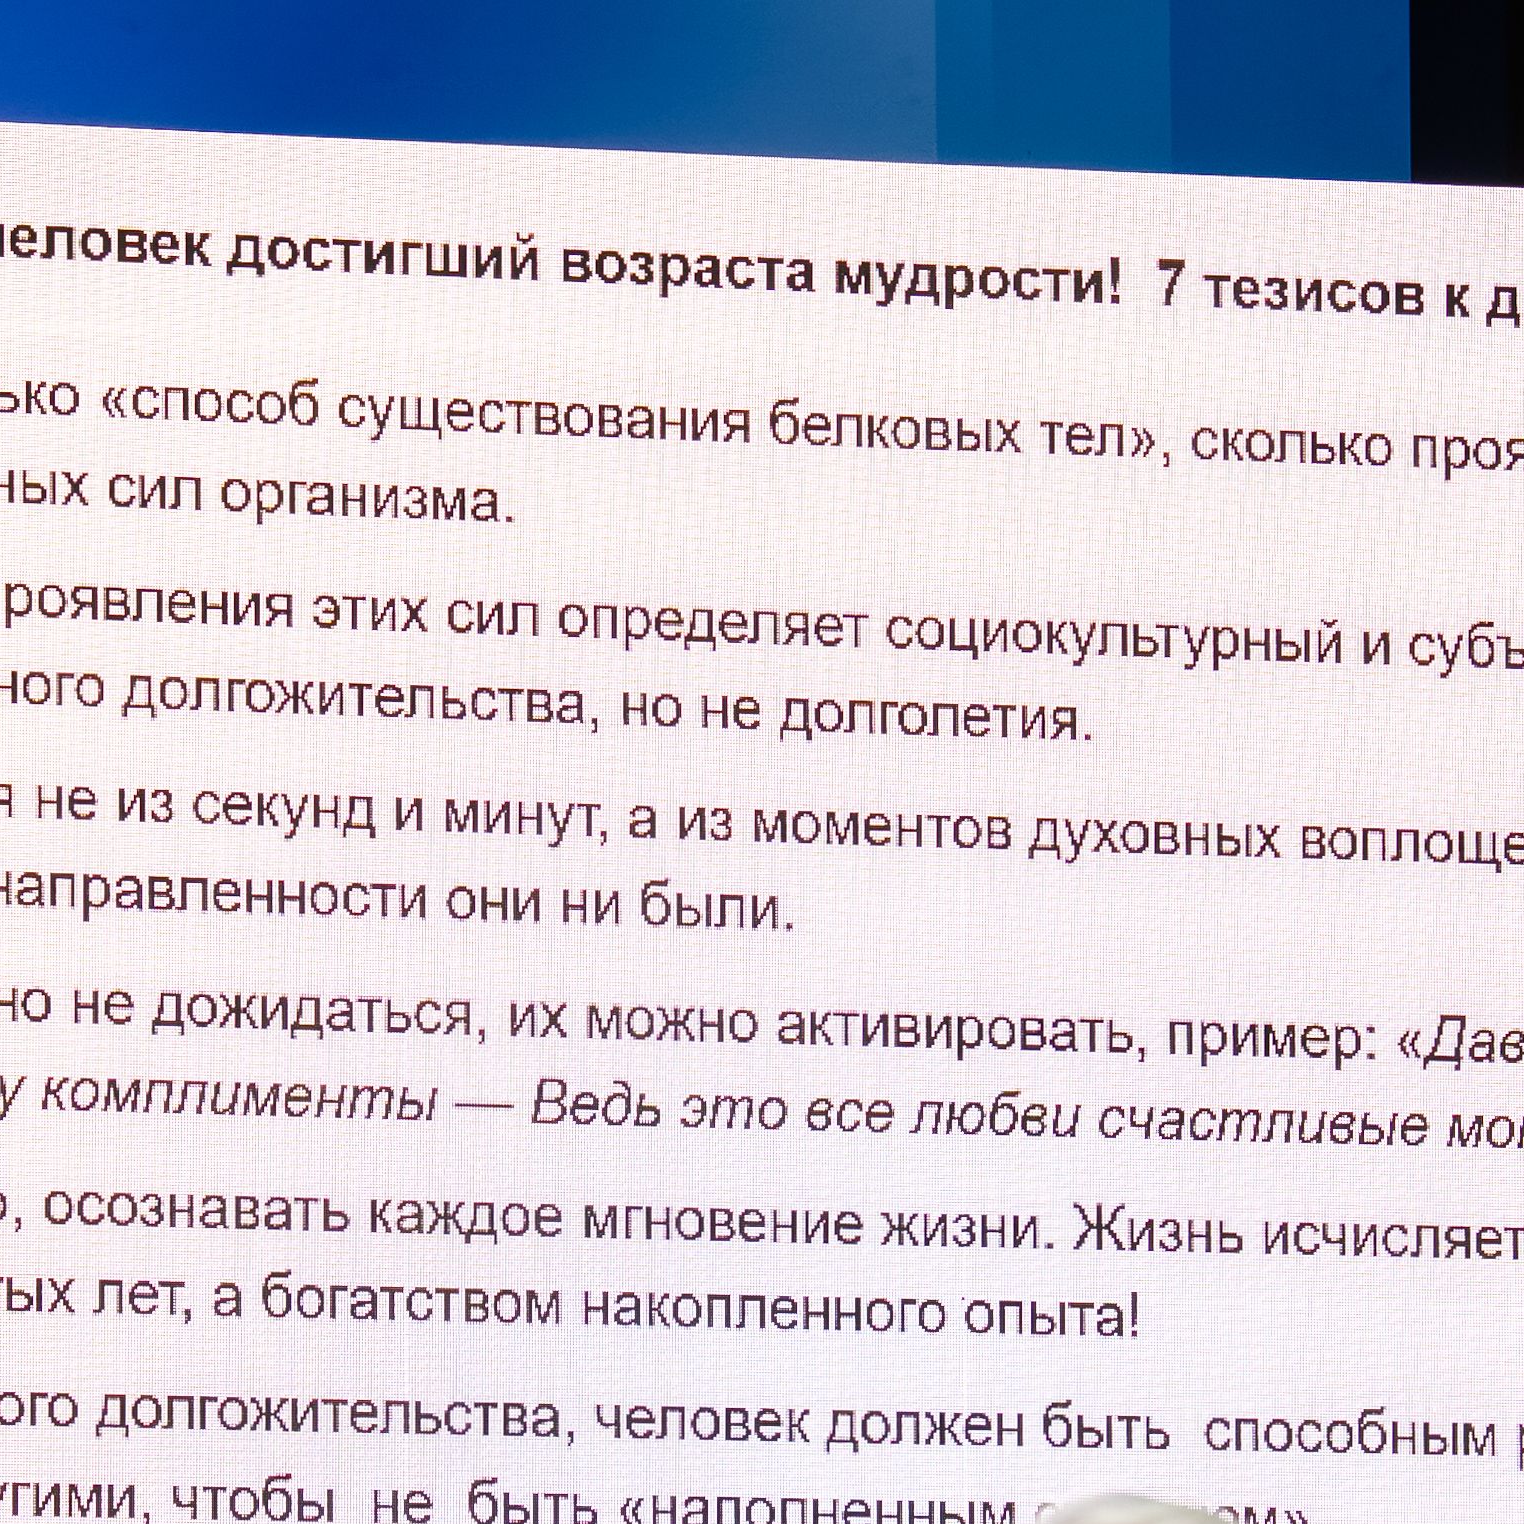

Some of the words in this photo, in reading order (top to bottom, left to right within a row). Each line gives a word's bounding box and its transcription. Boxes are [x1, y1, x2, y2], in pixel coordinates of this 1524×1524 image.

[223, 232, 541, 283] достигший
[561, 246, 817, 299] возраста
[833, 255, 1122, 312] мудрости!
[1155, 256, 1188, 307] 7
[1201, 272, 1426, 318] тезисов
[1443, 281, 1472, 320] к
[101, 376, 321, 428] «способ
[337, 392, 752, 444] существования
[768, 395, 1023, 455] белковых
[1038, 419, 1171, 469] тел»,
[1189, 426, 1394, 468] сколько
[107, 471, 203, 513] сил
[219, 476, 514, 527] организма.
[312, 592, 429, 634] этих
[445, 597, 541, 638] сил
[557, 602, 870, 653] определяет
[883, 613, 1344, 673] социокультурный
[1360, 629, 1393, 666] и
[120, 672, 599, 735] долгожительства,
[620, 691, 685, 730] но
[700, 693, 763, 732] не
[778, 695, 1092, 743] долголетия.
[35, 784, 99, 822] не
[116, 786, 175, 825] из
[190, 788, 378, 841] секунд
[393, 795, 424, 833] и
[444, 796, 608, 850] минут,
[626, 803, 658, 841] а
[676, 805, 733, 844] из
[751, 807, 1014, 852] моментов
[1027, 815, 1283, 865] духовных
[445, 883, 542, 924] они
[560, 887, 622, 926] ни
[639, 877, 794, 932] были.
[71, 988, 136, 1027] не
[150, 989, 487, 1044] дожидаться,
[508, 1001, 569, 1039] их
[586, 1003, 761, 1045] можно
[776, 1008, 1148, 1064] активировать,
[1166, 1018, 1377, 1073] пример:
[40, 1075, 439, 1123] комплименты
[530, 1075, 662, 1129] Ведь
[678, 1093, 790, 1131] это
[805, 1095, 896, 1135] все
[909, 1088, 1082, 1140] любви
[1097, 1104, 1431, 1149] счастливые
[43, 1189, 351, 1234] осознавать
[369, 1197, 563, 1246] каждое
[582, 1202, 865, 1247] мгновение
[881, 1210, 1054, 1251] жизни.
[1072, 1201, 1246, 1256] Жизнь
[92, 1276, 193, 1325] лет,
[211, 1280, 244, 1319] а
[259, 1268, 563, 1326] богатством
[582, 1289, 948, 1336] накопленного
[963, 1290, 1139, 1339] опыта!
[93, 1392, 576, 1445] долгожительства,
[594, 1403, 811, 1444] человек
[823, 1407, 1026, 1455] должен
[1040, 1397, 1171, 1452] быть
[1203, 1406, 1498, 1458] способным
[171, 1472, 336, 1524] чтобы
